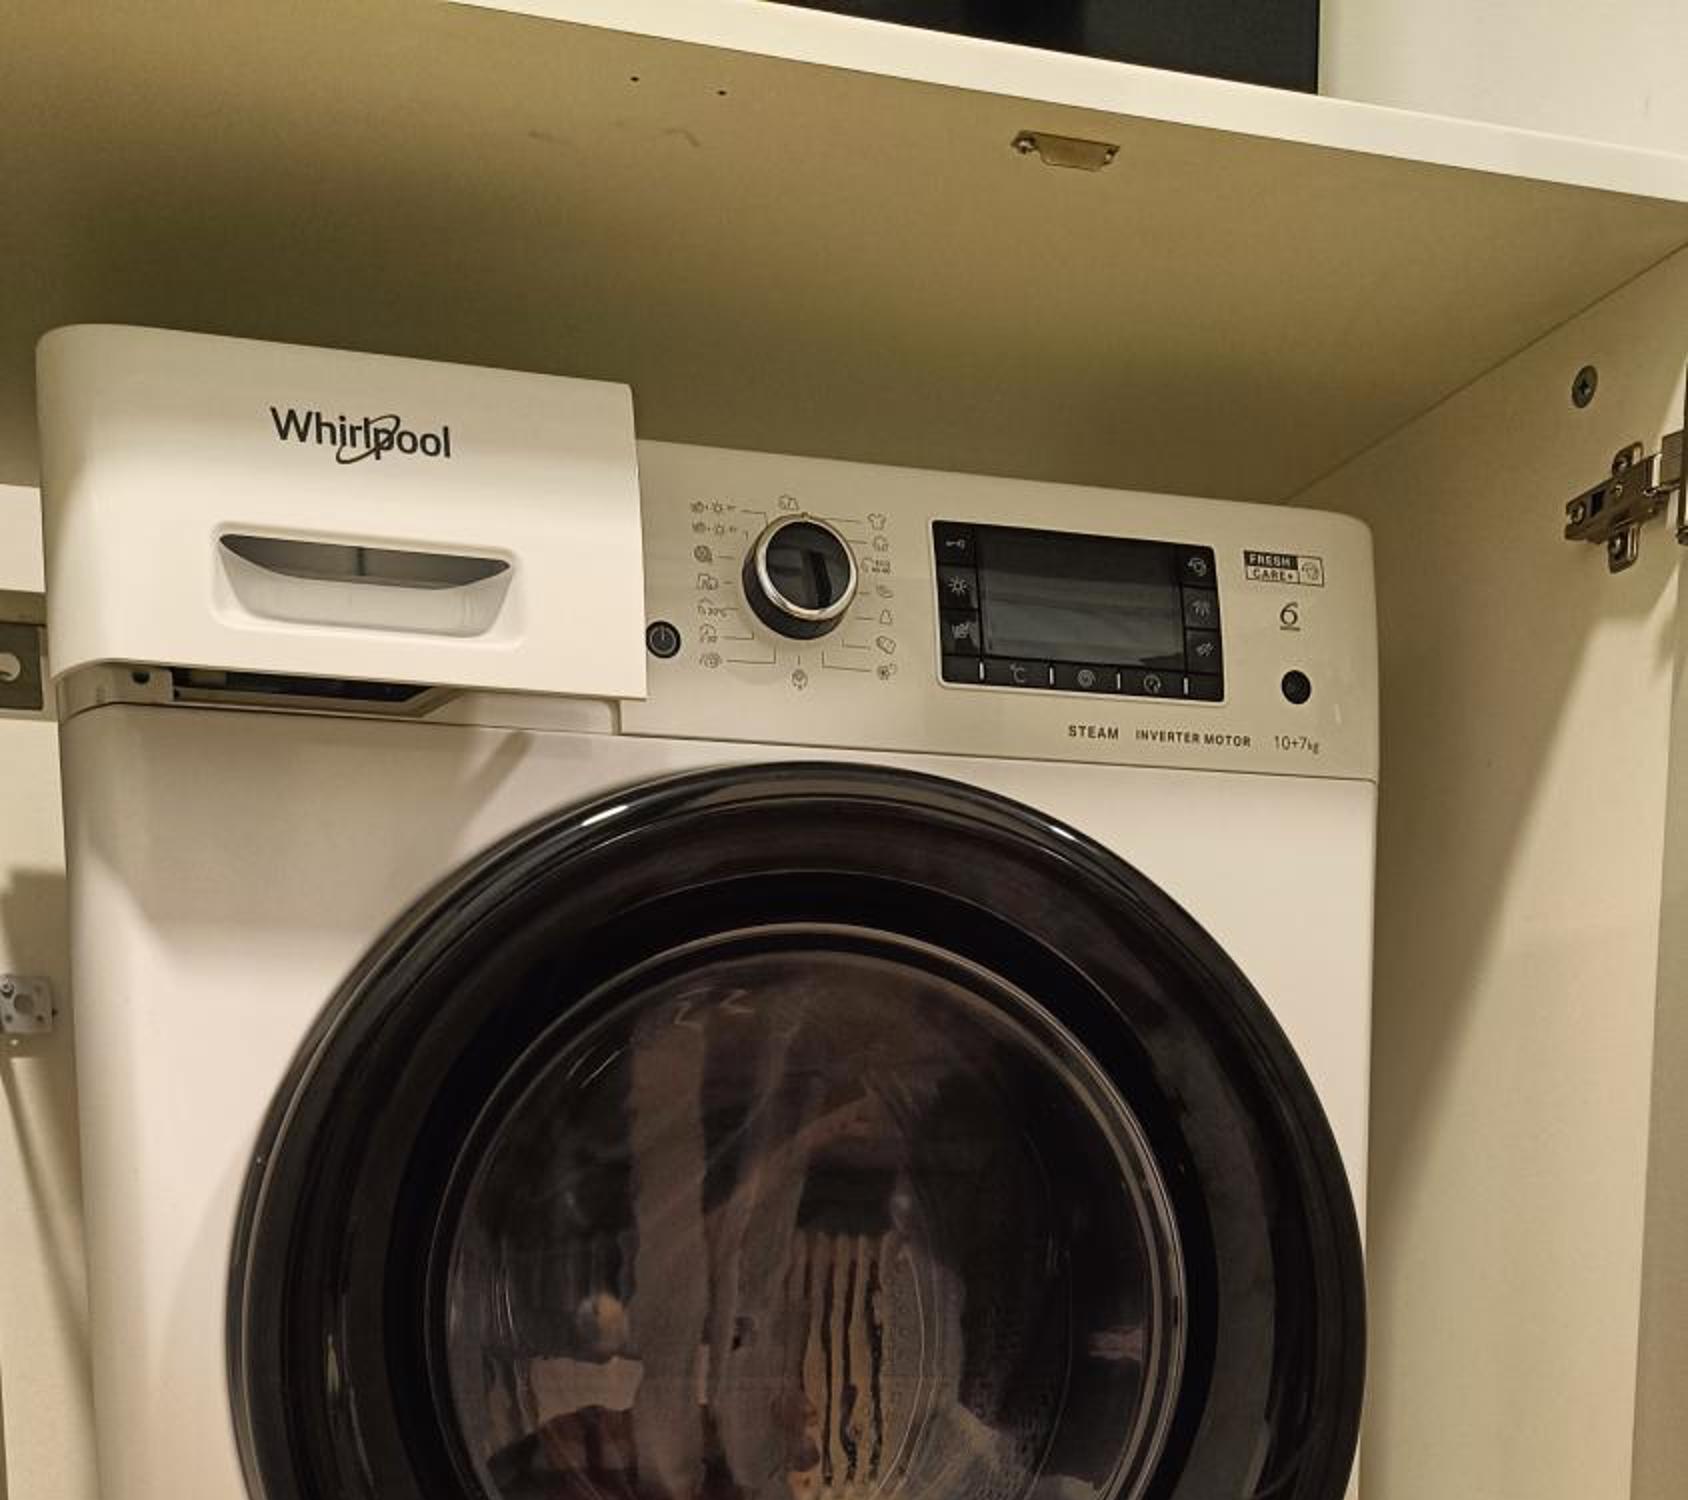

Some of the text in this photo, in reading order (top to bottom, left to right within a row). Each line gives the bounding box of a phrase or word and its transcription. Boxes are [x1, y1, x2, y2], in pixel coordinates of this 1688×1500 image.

[270, 406, 451, 464] Whirlpool
[1248, 554, 1291, 567] FRESH
[1067, 724, 1119, 740] STEAM
[1135, 729, 1252, 748] INVERTER MOTOR
[1273, 735, 1320, 754] 10+7kg
